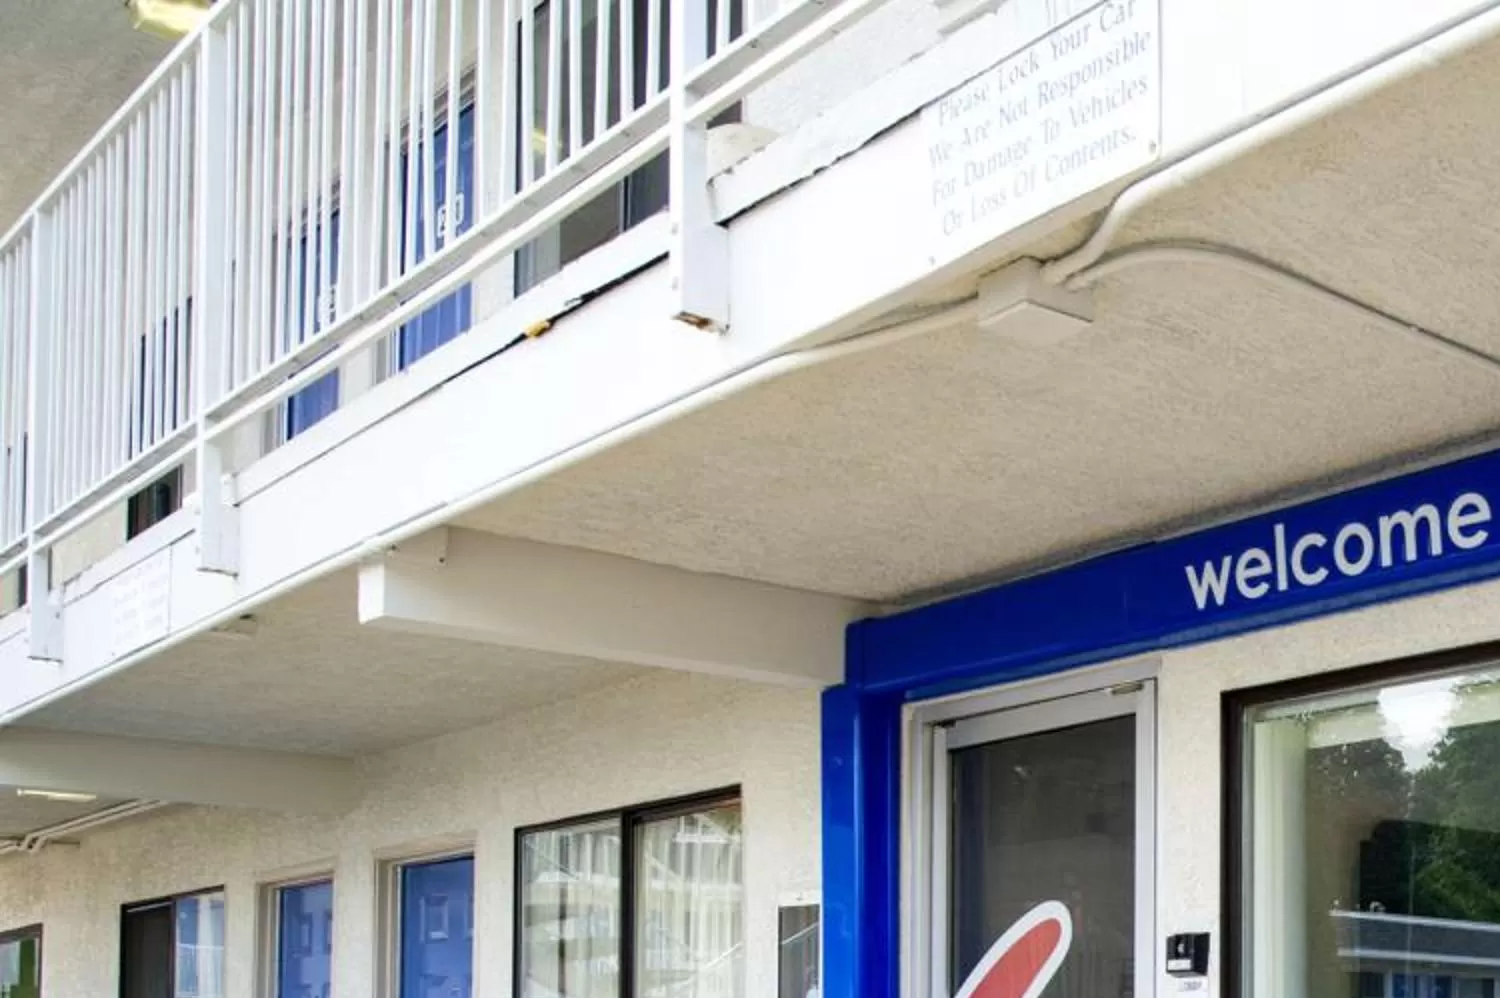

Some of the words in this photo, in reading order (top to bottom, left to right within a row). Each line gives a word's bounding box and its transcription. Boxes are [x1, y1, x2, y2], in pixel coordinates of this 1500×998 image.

[928, 140, 953, 169] We
[961, 119, 991, 147] Are
[999, 96, 1028, 129] Not
[1037, 32, 1151, 108] Responsible
[938, 82, 990, 127] Please
[996, 51, 1040, 93] Lock
[1049, 22, 1091, 61] Your
[1099, 0, 1135, 33] Car
[932, 178, 957, 207] For
[964, 136, 1032, 187] Damage
[1040, 117, 1061, 145] To
[1068, 74, 1148, 129] Vehicles
[943, 209, 964, 236] Or
[971, 190, 1007, 223] Loss
[1013, 164, 1038, 198] Of
[1045, 125, 1137, 183] Contents.
[1185, 492, 1493, 611] welcome
